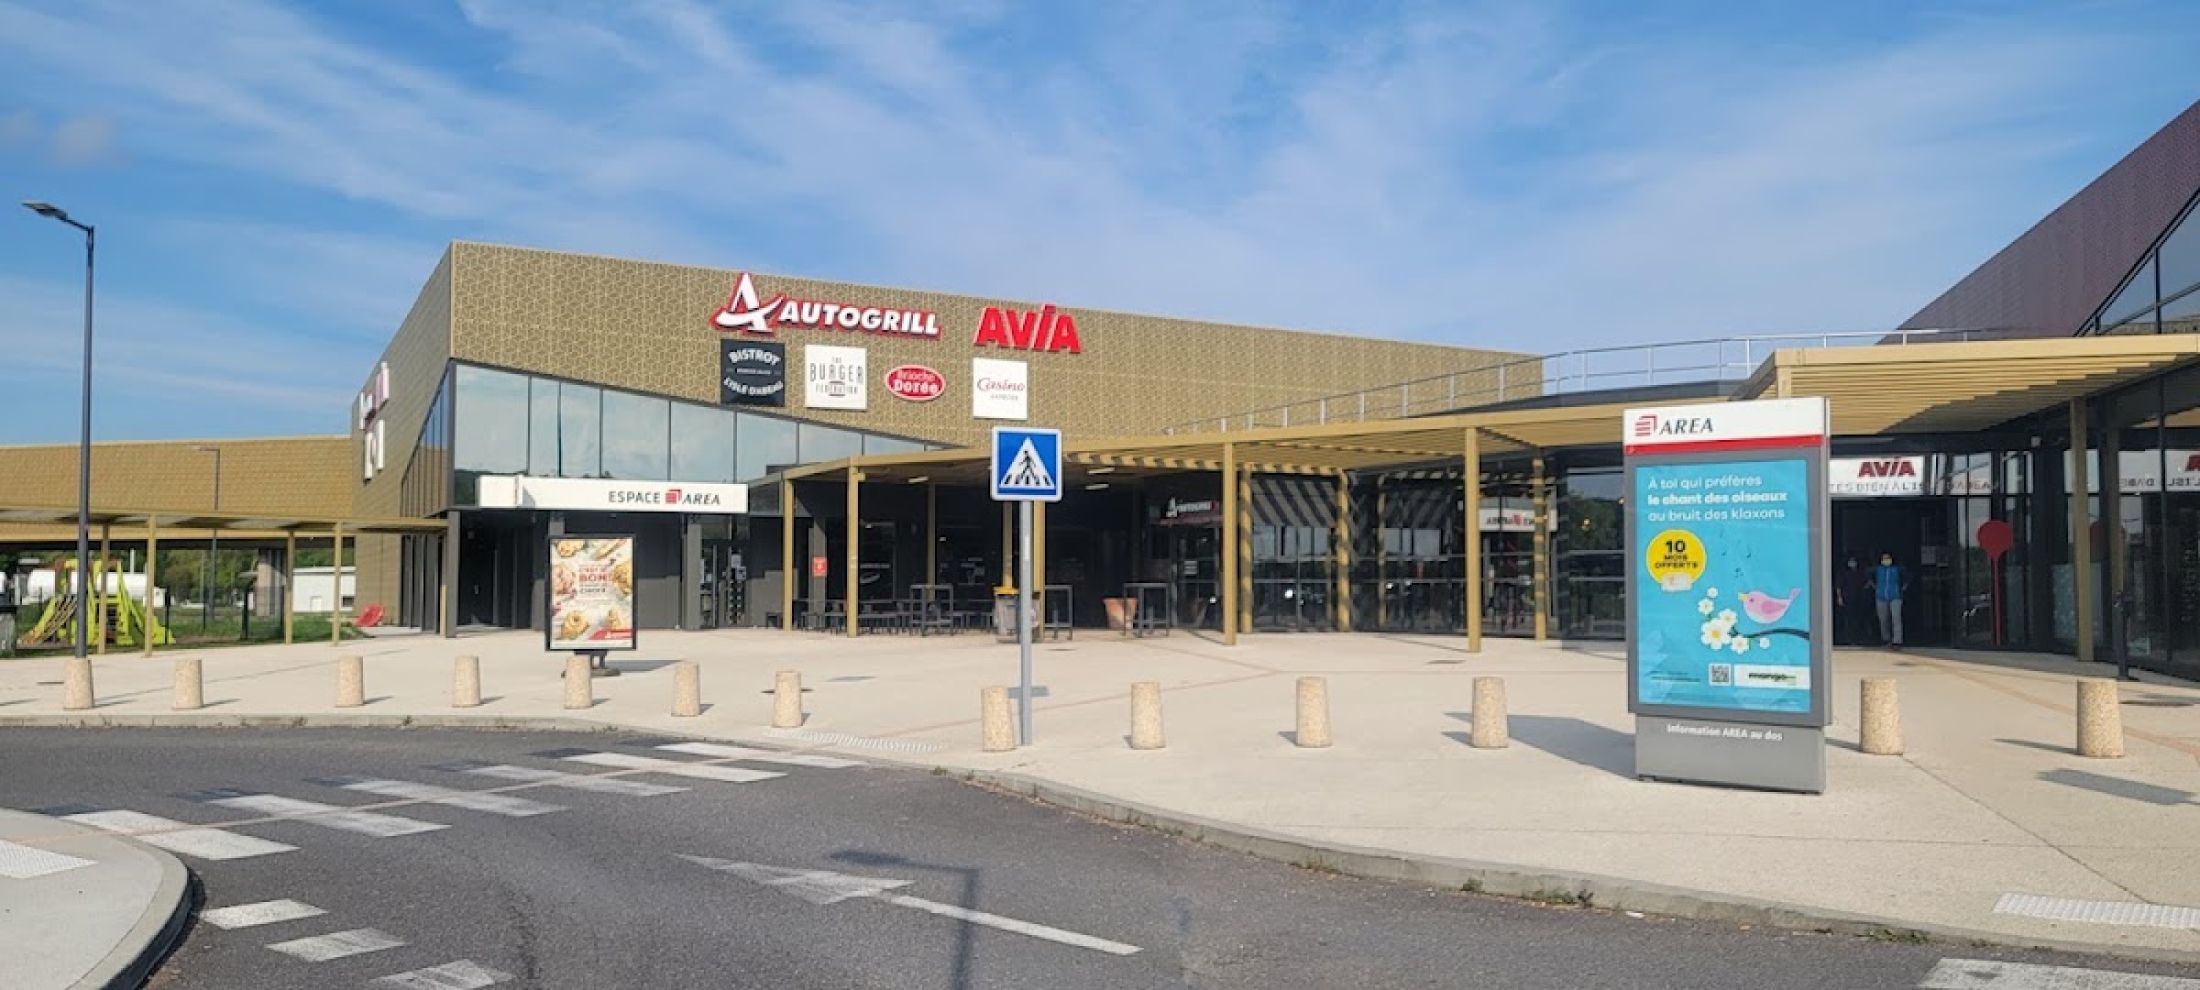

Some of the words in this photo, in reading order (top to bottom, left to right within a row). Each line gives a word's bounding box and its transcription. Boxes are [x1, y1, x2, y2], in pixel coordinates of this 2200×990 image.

[778, 300, 942, 336] AUTOGRILL
[728, 347, 782, 366] BISTROT
[809, 363, 864, 383] BURGER
[977, 377, 1026, 392] Casino
[1659, 418, 1714, 435] AREA
[1660, 479, 1678, 489] toi
[1680, 477, 1701, 490] qui
[1705, 475, 1763, 490] préfères
[608, 490, 661, 504] ESPACE
[682, 492, 721, 505] AREA
[1648, 494, 1660, 505] le
[1662, 493, 1702, 505] chant
[1705, 493, 1729, 504] des
[1732, 490, 1788, 503] oiseaux
[1648, 511, 1665, 521] au
[1669, 509, 1701, 521] bruit
[1704, 509, 1728, 520] des
[1732, 508, 1785, 519] klaxons
[1666, 540, 1686, 553] 10
[1655, 561, 1698, 569] OFFERTS
[1667, 722, 1721, 736] Information
[1722, 727, 1748, 738] AREA
[1750, 731, 1763, 739] au
[1765, 729, 1783, 741] dos
